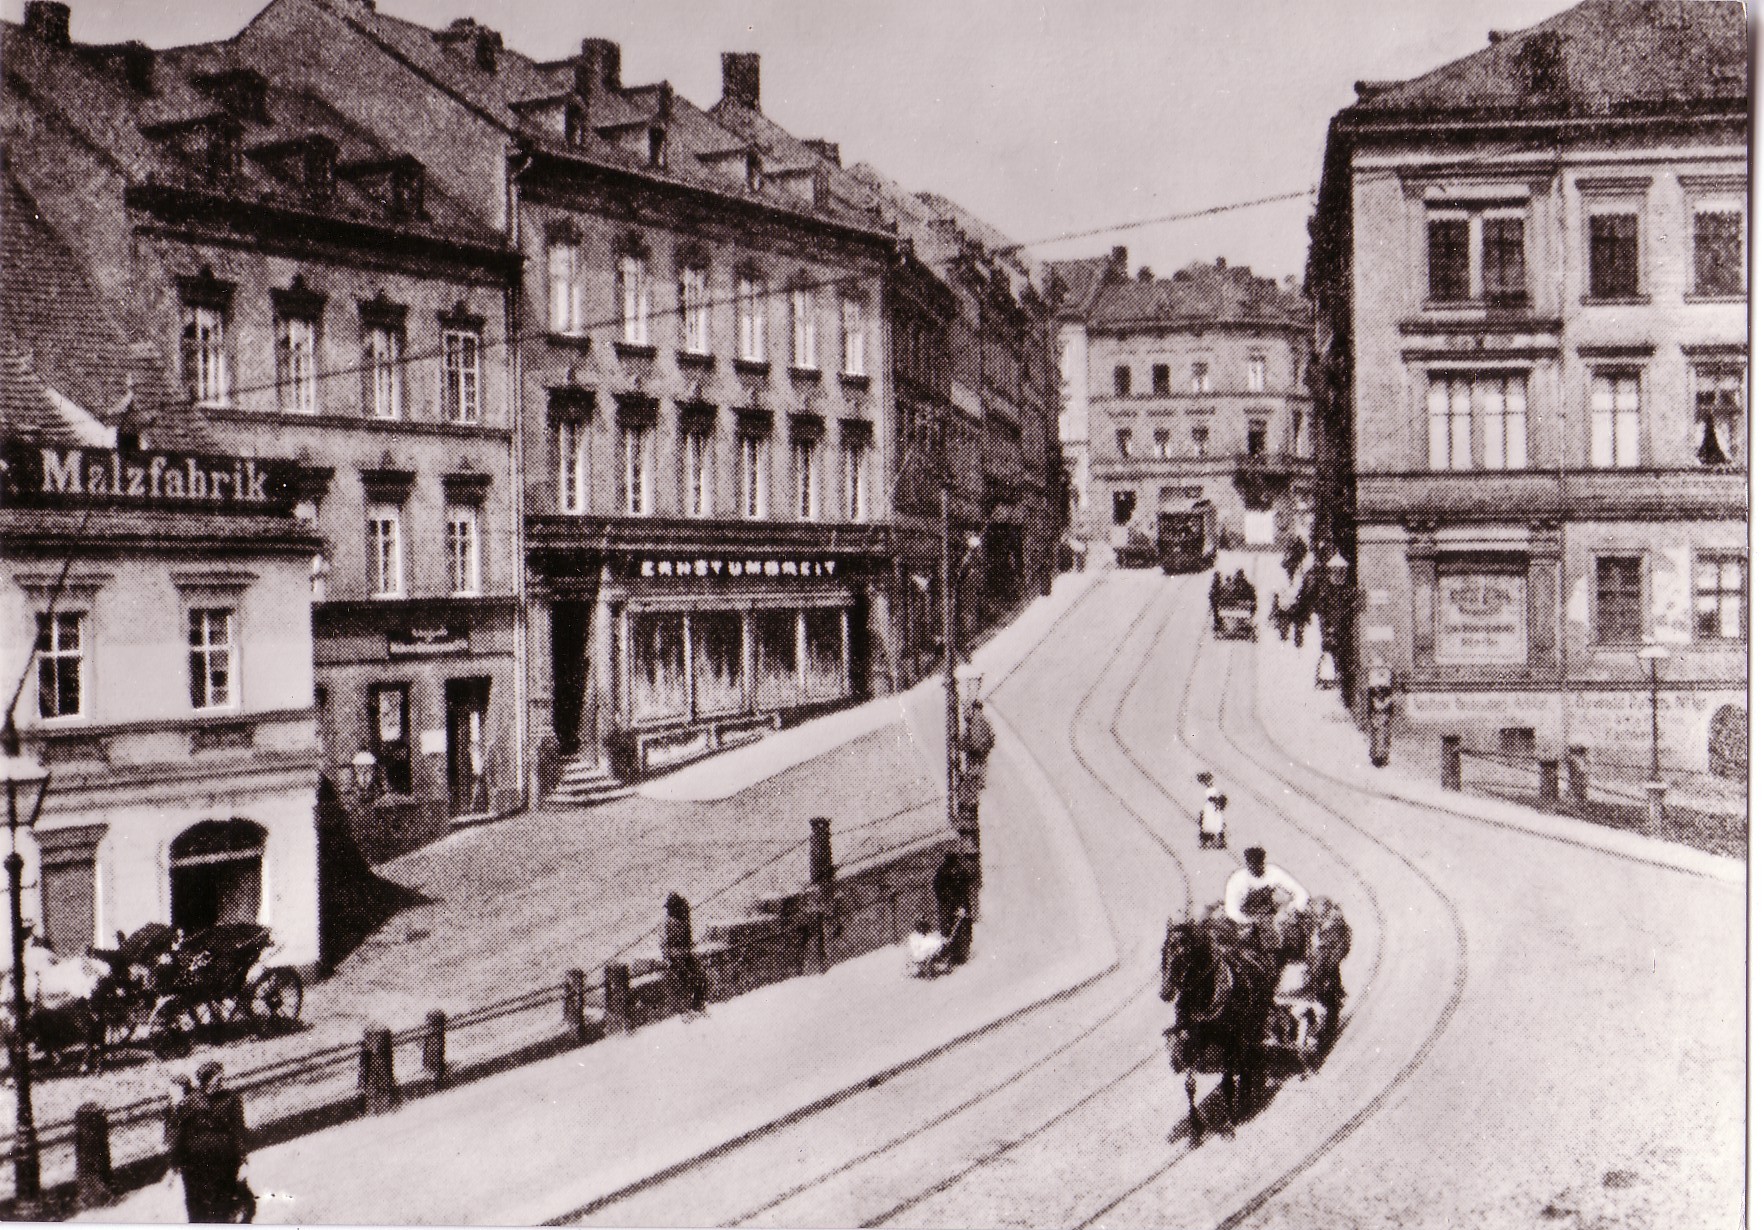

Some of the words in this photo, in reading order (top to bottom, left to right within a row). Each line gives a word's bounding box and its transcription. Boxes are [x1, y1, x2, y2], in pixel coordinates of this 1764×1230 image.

[41, 449, 268, 500] Malzfabrik
[640, 559, 723, 577] ERNST
[728, 559, 836, 577] UMBREIT
